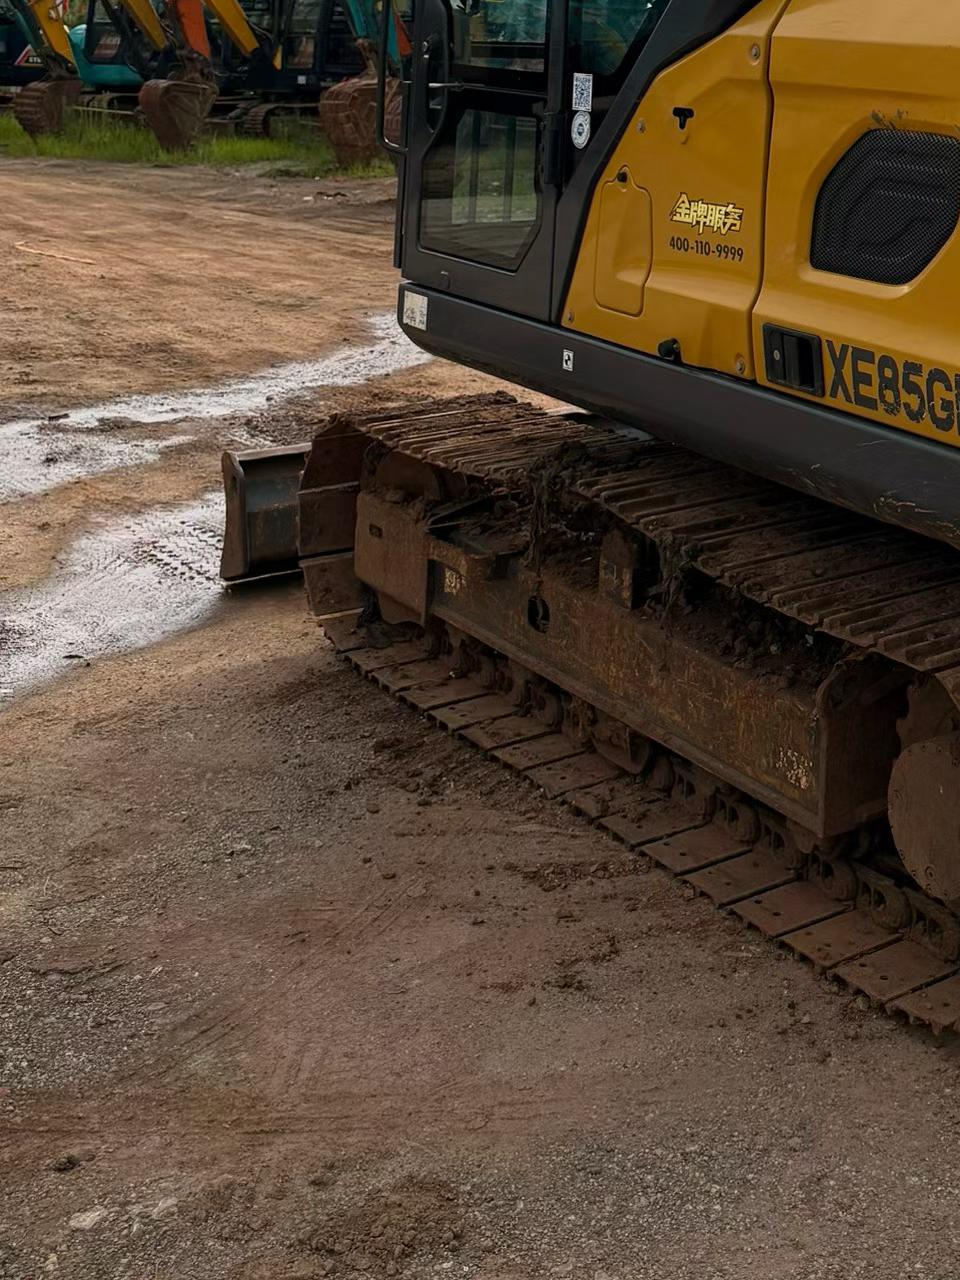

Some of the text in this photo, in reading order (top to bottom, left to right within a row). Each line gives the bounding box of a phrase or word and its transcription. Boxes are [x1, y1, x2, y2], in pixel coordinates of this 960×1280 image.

[670, 192, 744, 235] 金牌服务
[669, 236, 744, 261] 400-110-9999
